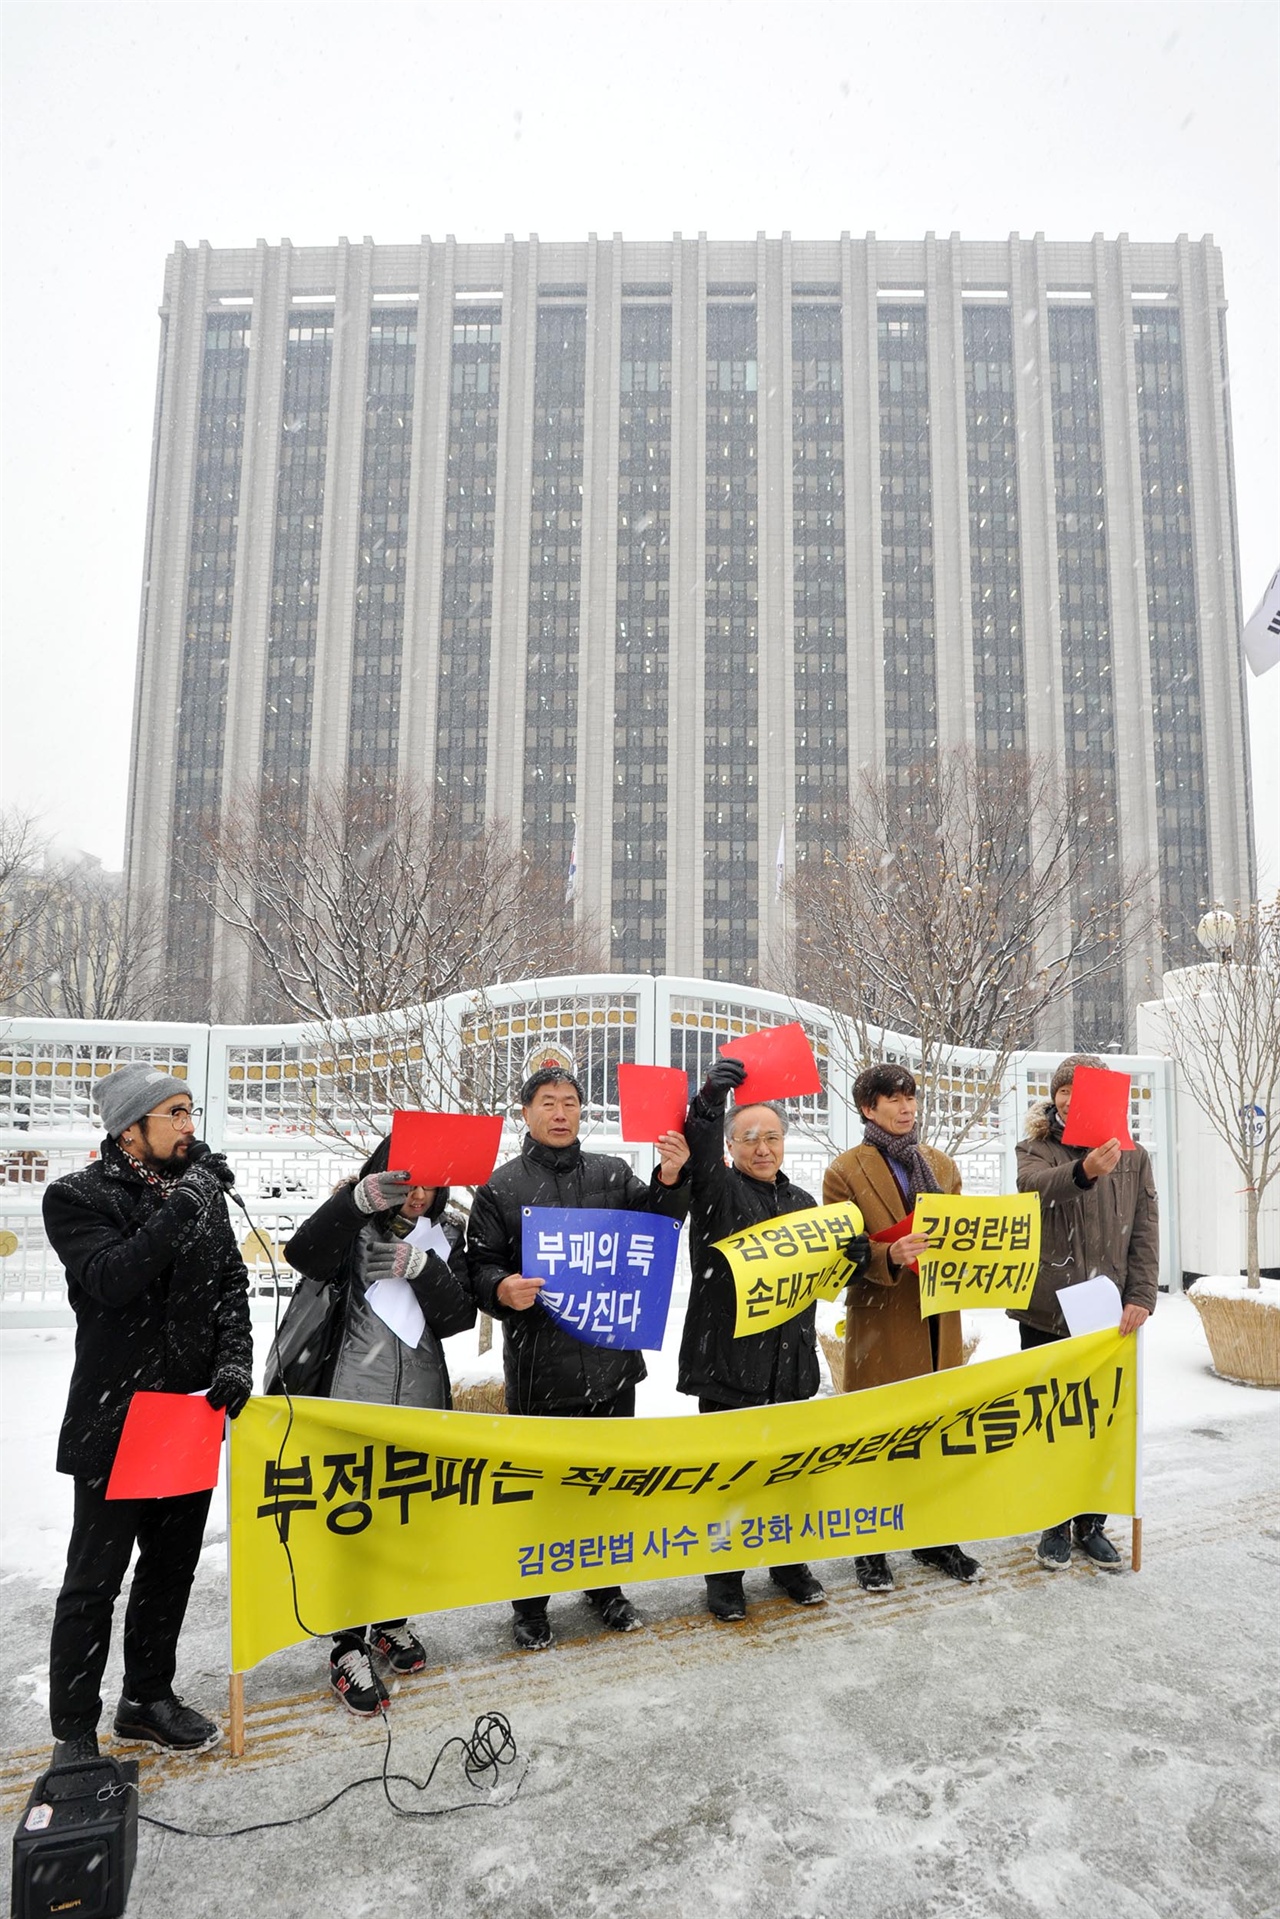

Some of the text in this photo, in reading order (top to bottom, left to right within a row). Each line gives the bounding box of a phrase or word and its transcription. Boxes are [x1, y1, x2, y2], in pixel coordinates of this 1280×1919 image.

[536, 1231, 655, 1276] 부패의 둑
[727, 1214, 857, 1262] 김영란법
[922, 1213, 1032, 1251] 김영란법
[920, 1261, 1035, 1297] 개악저지!
[257, 1366, 1124, 1544] 부정부패는 적폐다! 김영란법 건들지마!
[516, 1503, 905, 1578] 김영란법 사수 및 강화 시민연대
[337, 1676, 350, 1694] N
